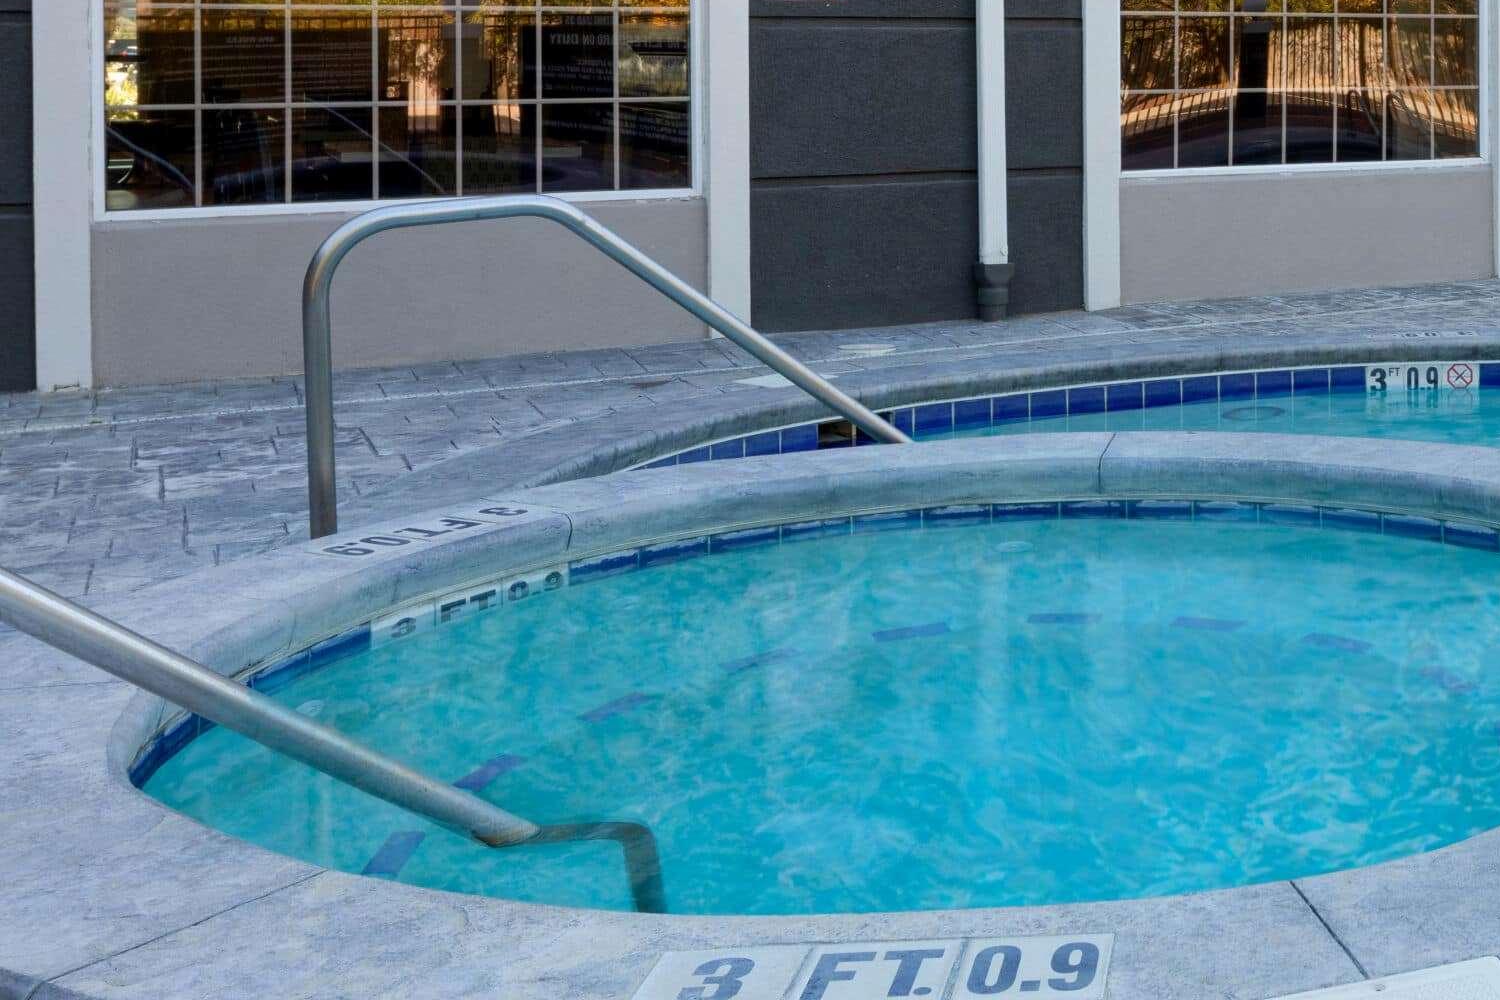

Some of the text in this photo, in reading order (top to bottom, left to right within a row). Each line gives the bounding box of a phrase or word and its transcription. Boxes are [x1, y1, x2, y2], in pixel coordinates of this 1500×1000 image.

[1369, 367, 1387, 392] 3
[1388, 367, 1401, 377] FT
[478, 506, 529, 517] 3
[390, 616, 417, 638] 3
[677, 941, 1100, 1000] 3 FT. 0.9
